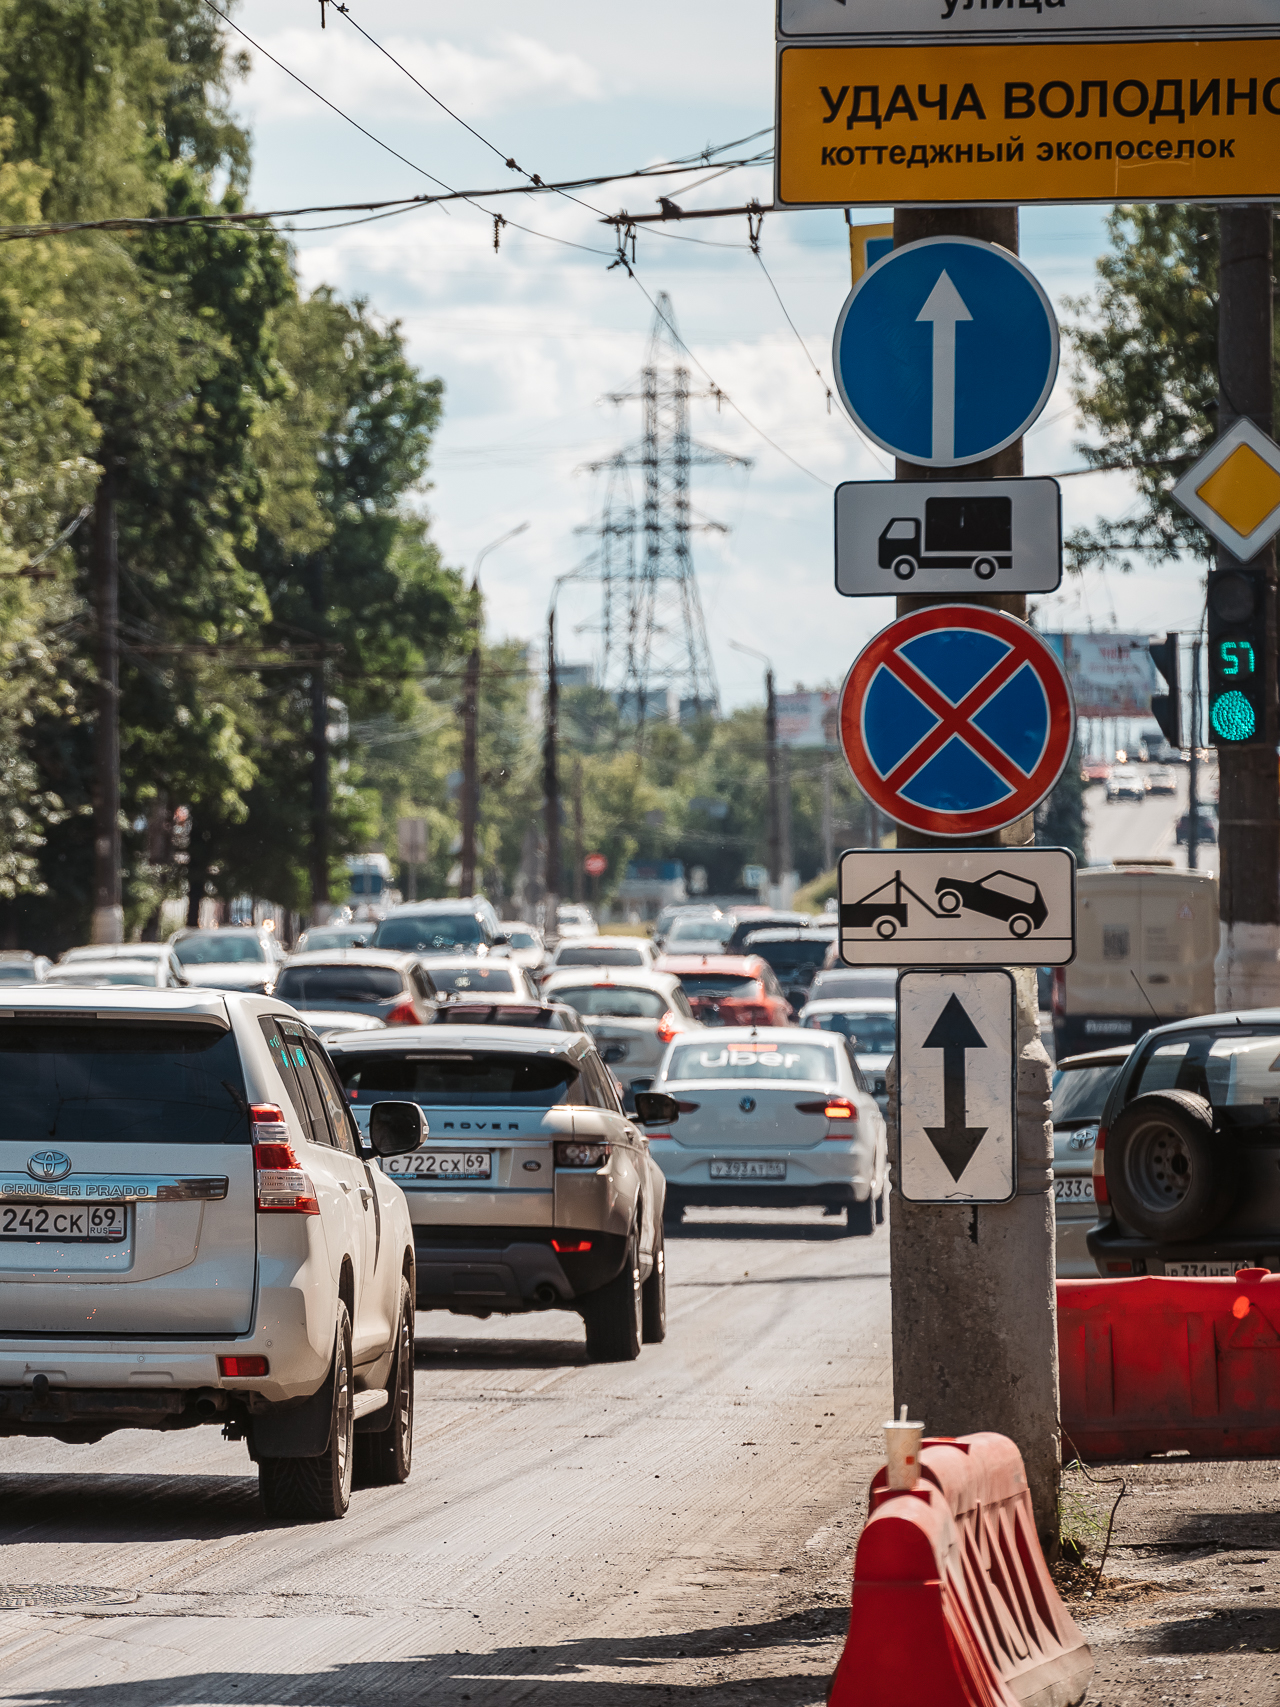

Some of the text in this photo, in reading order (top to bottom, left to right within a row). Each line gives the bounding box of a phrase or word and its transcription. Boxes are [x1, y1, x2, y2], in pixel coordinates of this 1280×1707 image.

[819, 83, 987, 130] УДАЧА
[821, 135, 1236, 168] коттеджный экопоселок
[1221, 641, 1255, 675] 57
[444, 1122, 520, 1131] ROVER
[466, 1155, 485, 1169] 69
[1, 1184, 81, 1196] CRUISER
[86, 1185, 149, 1197] PRADO
[90, 1208, 116, 1227] 69
[90, 1226, 108, 1235] RUS
